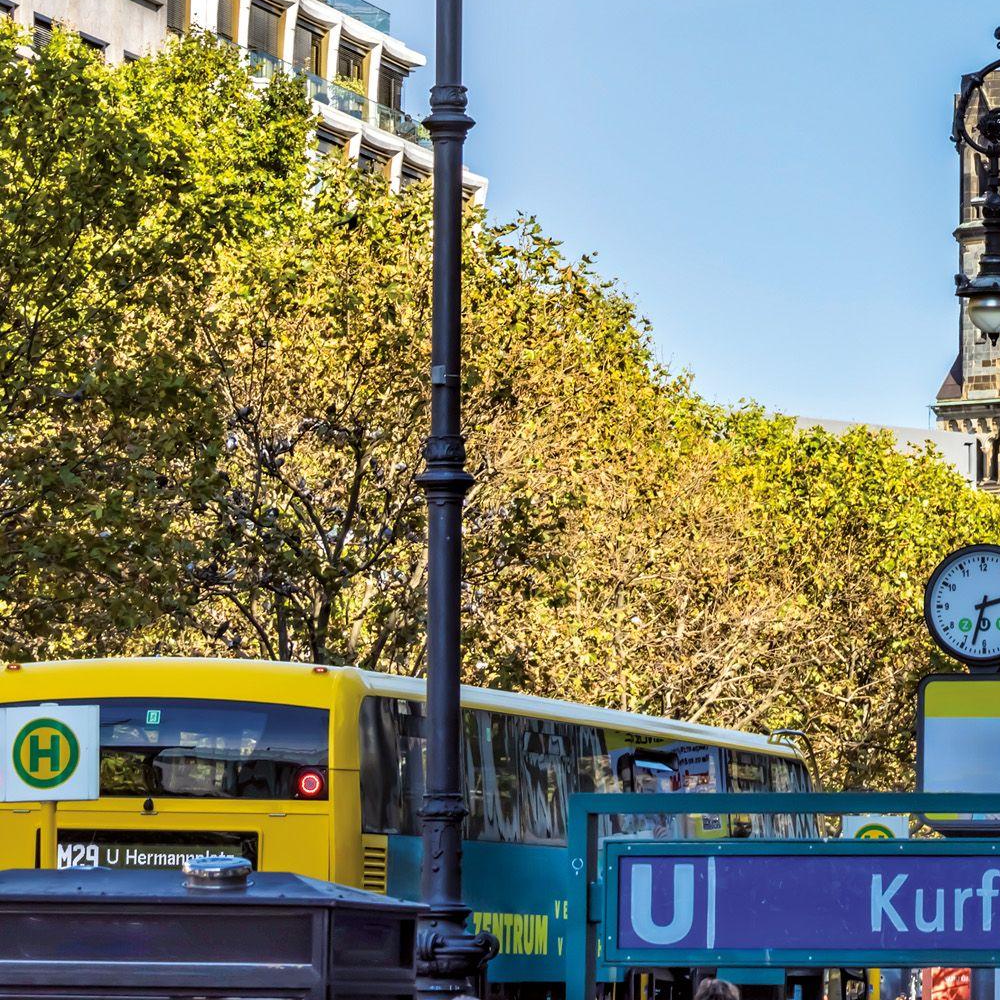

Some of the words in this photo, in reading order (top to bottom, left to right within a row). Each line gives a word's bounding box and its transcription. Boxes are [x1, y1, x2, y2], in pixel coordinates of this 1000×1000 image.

[979, 564, 988, 572] 12
[950, 621, 954, 629] 8
[963, 635, 968, 643] 7
[29, 735, 60, 773] H
[57, 844, 99, 869] M29
[106, 849, 119, 865] U
[125, 849, 235, 866] Hermann
[631, 864, 695, 944] U
